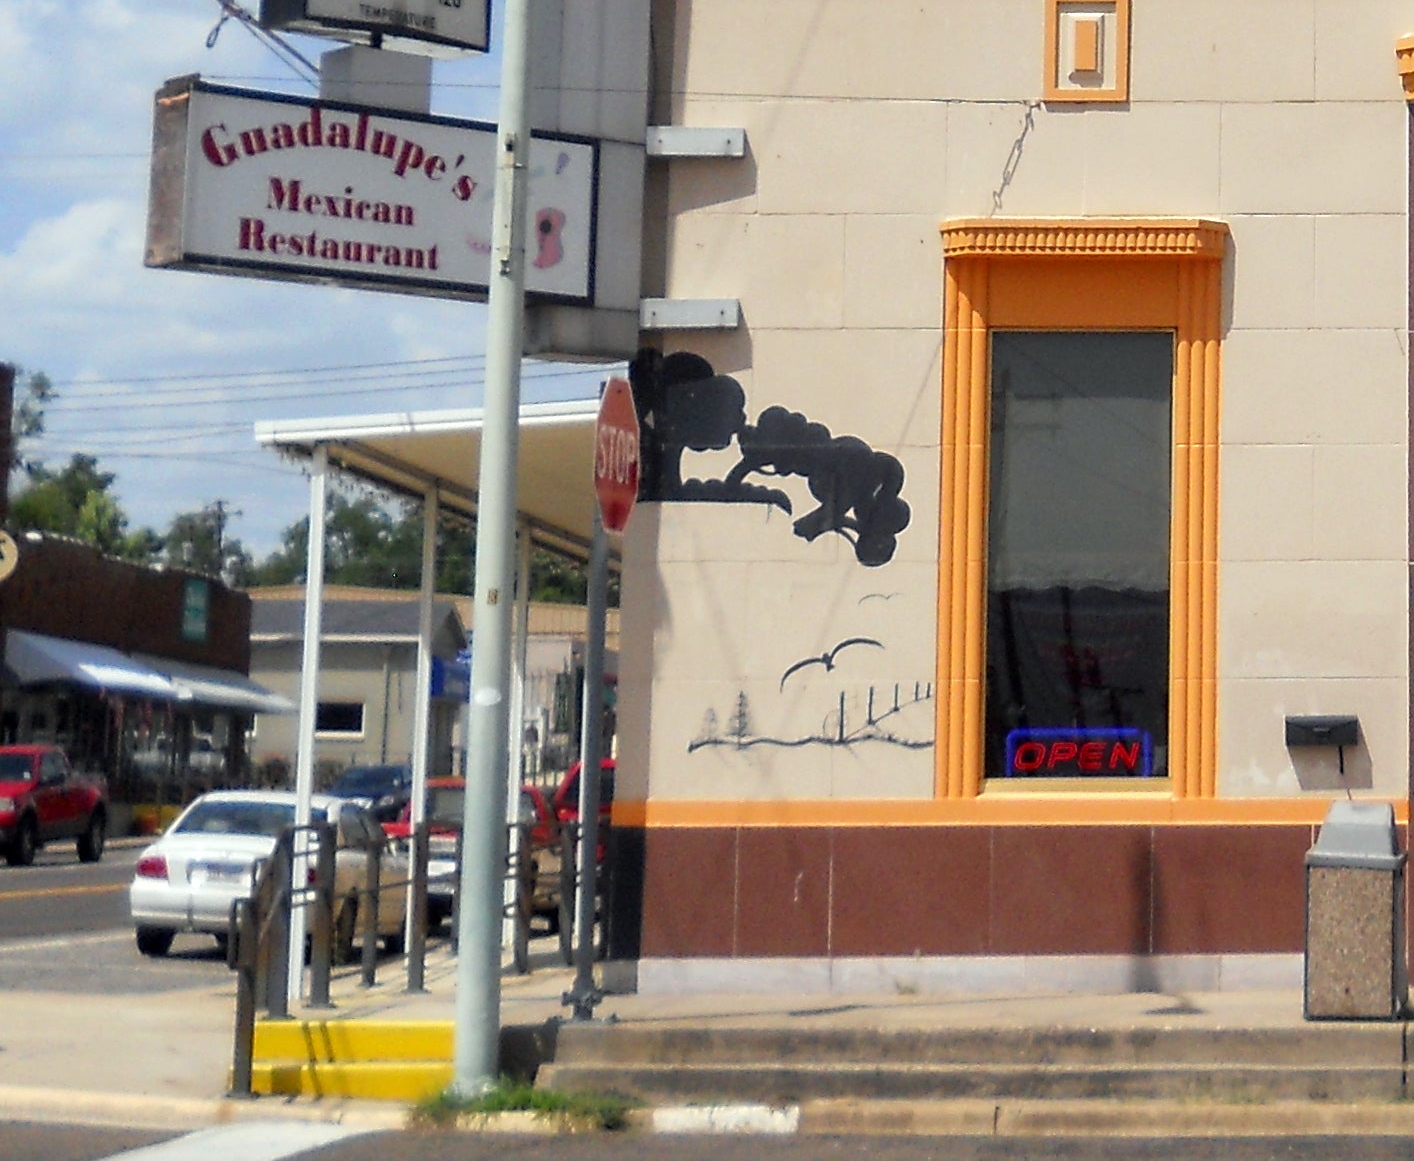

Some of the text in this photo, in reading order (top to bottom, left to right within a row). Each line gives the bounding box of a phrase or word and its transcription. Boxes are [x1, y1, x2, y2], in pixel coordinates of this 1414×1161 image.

[202, 107, 477, 201] Guadalupe's
[267, 176, 415, 227] Mexican
[237, 217, 439, 272] Restaurant
[598, 425, 636, 484] STOP
[1014, 742, 1140, 770] OPEN
